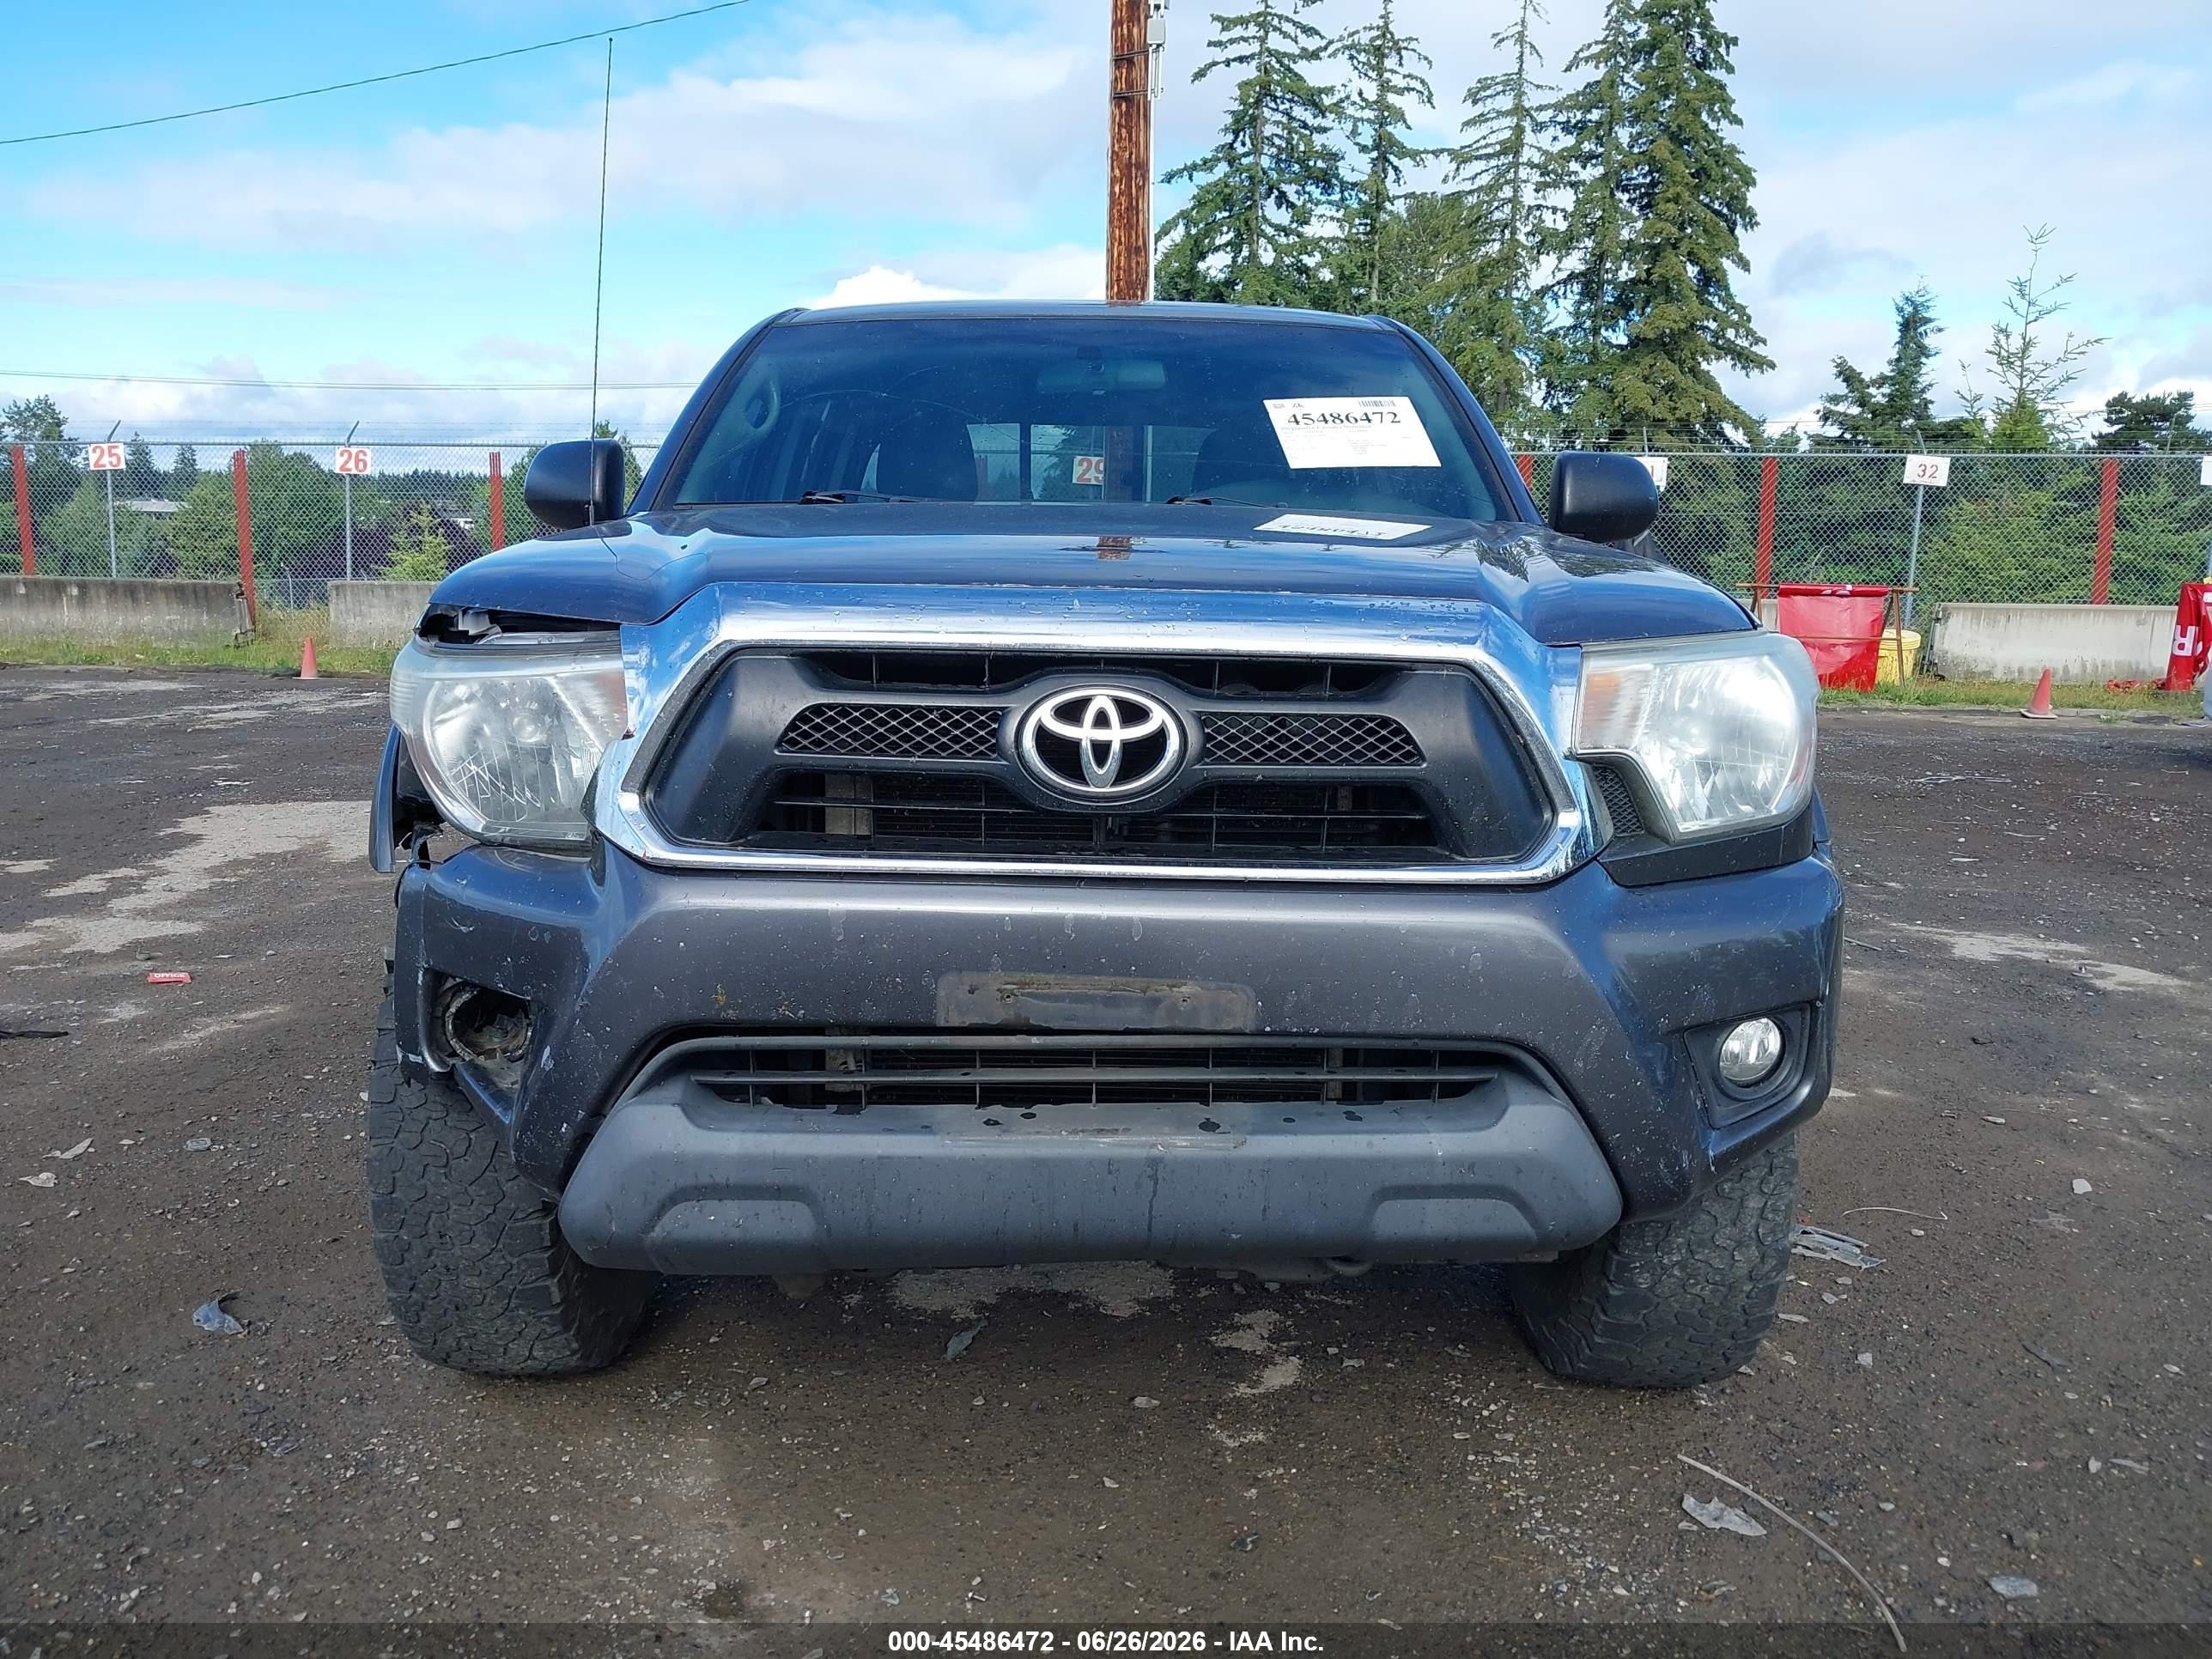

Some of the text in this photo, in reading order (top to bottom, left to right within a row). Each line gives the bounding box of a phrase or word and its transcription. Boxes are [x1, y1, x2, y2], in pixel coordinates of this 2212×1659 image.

[1287, 411, 1401, 426] 45486472
[92, 445, 121, 468] 25
[338, 449, 368, 472] 26
[1917, 464, 1939, 479] 32
